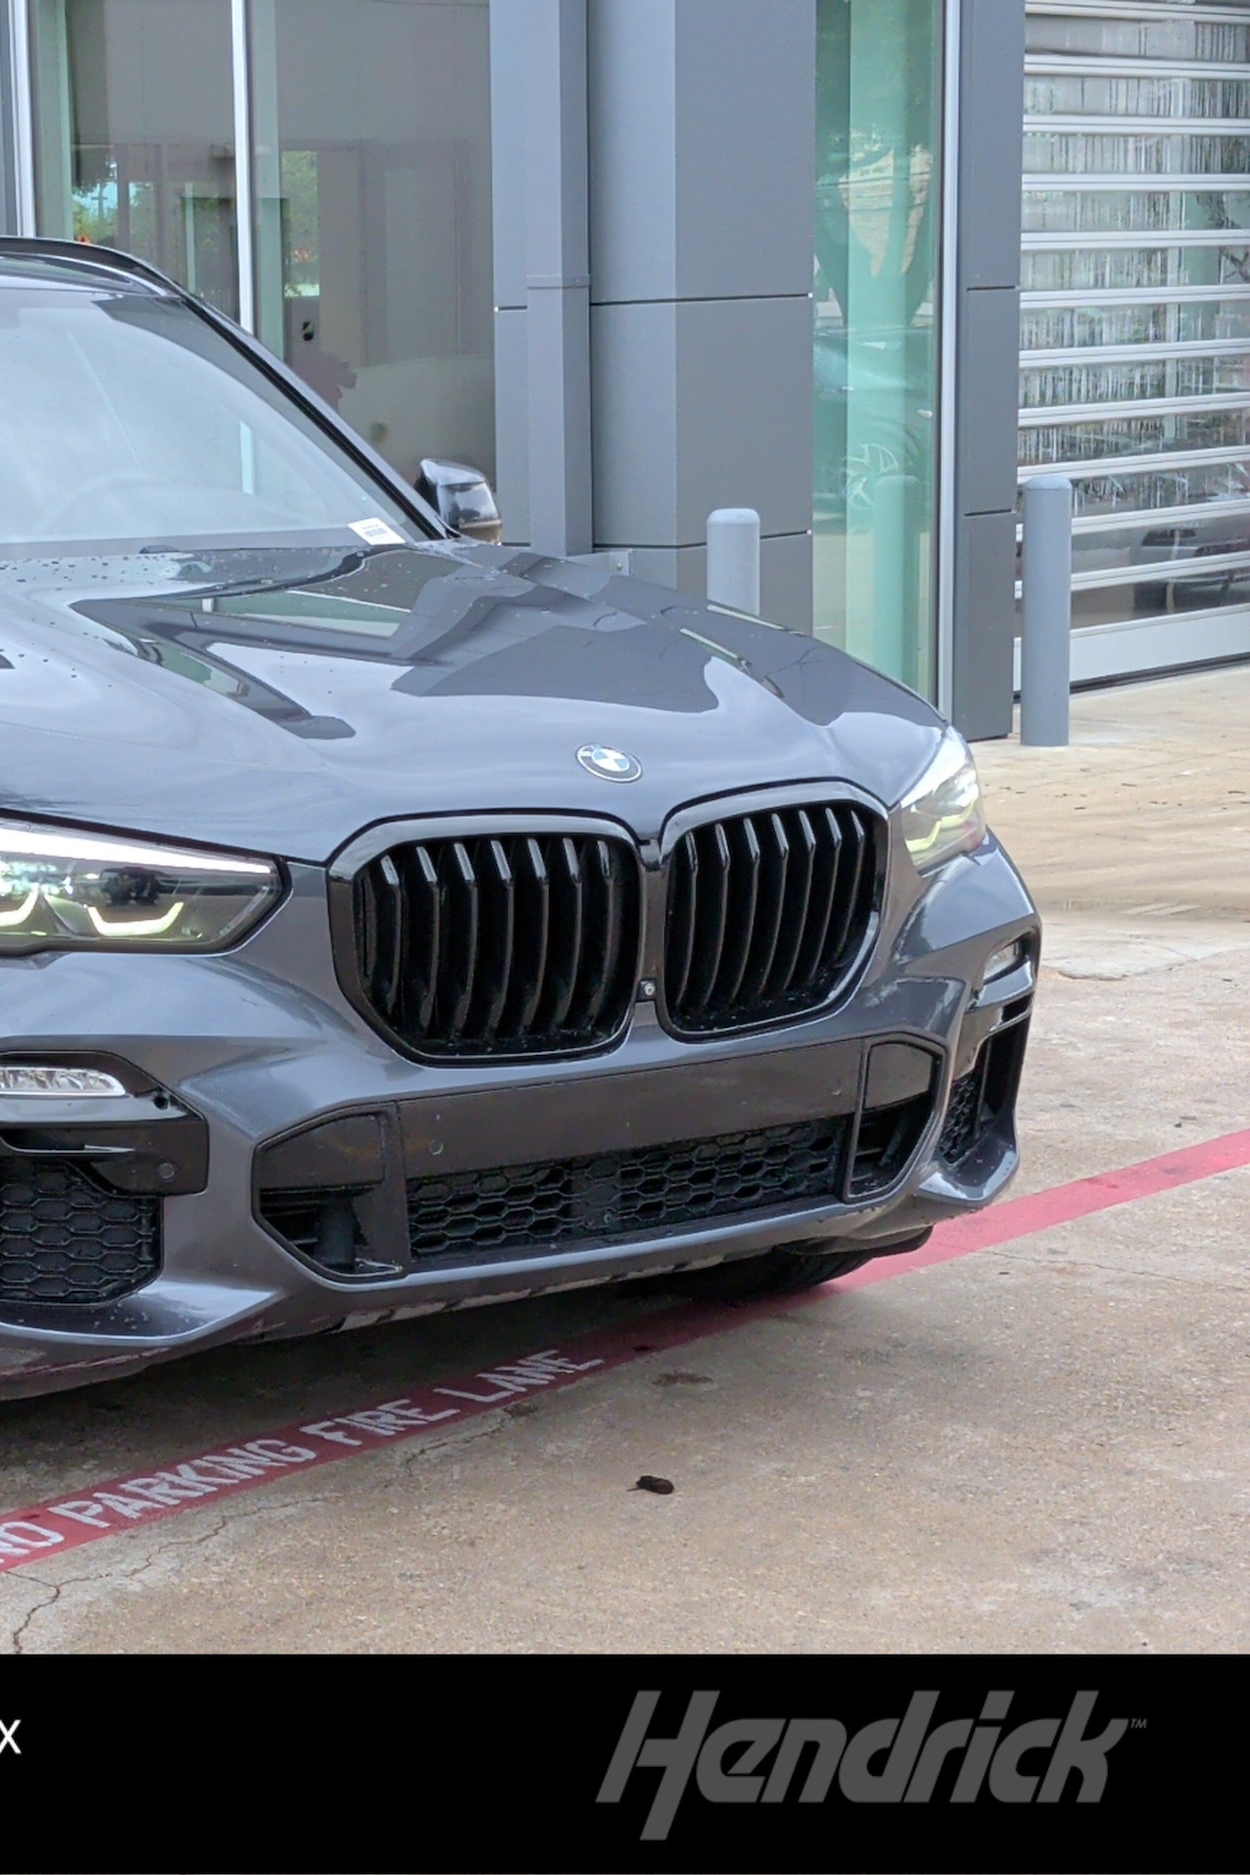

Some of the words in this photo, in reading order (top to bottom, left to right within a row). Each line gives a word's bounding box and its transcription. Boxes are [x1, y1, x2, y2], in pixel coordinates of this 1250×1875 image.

[48, 1439, 317, 1528] PARKING
[299, 1399, 461, 1447] FIRE
[432, 1349, 605, 1402] LANE
